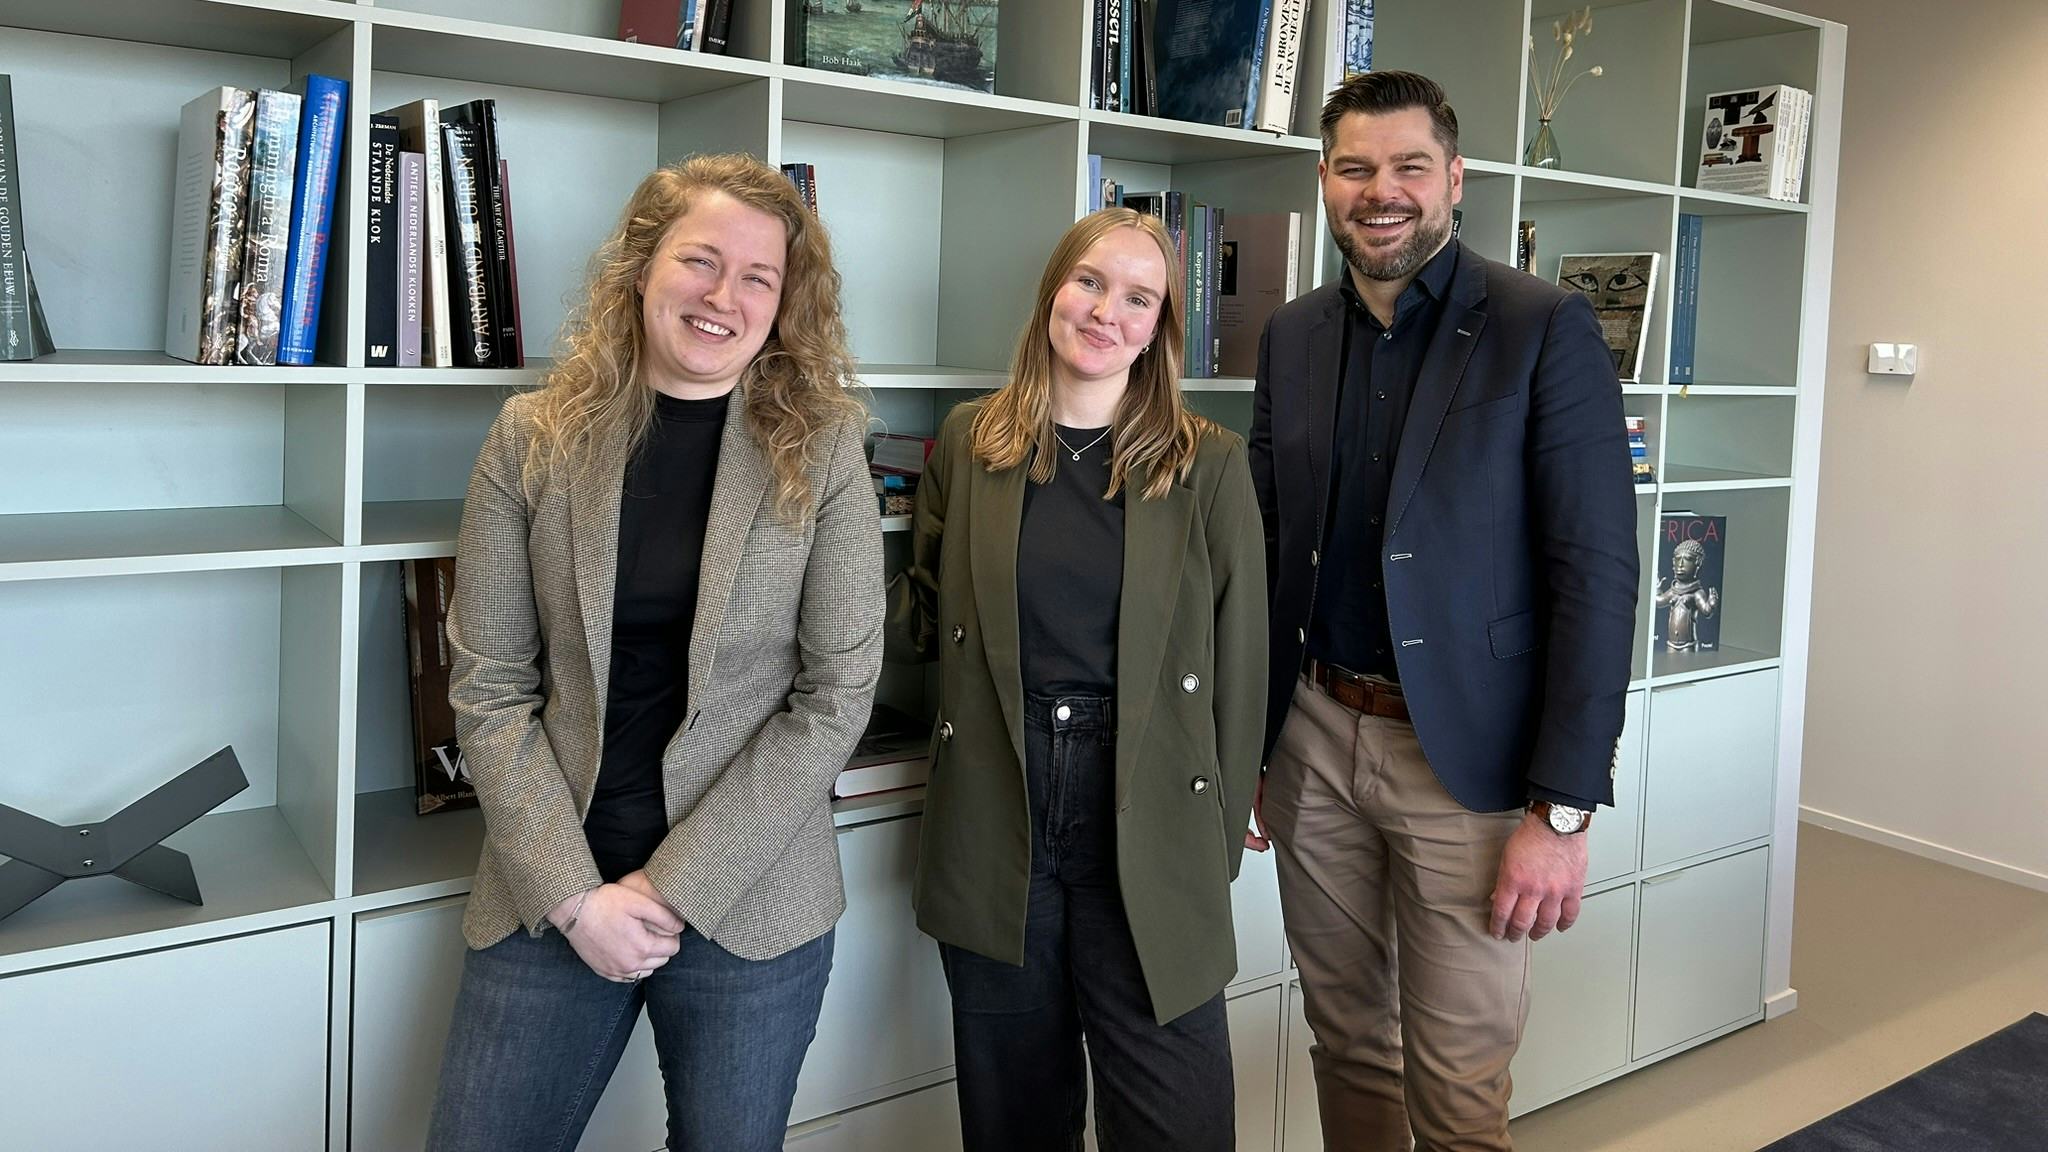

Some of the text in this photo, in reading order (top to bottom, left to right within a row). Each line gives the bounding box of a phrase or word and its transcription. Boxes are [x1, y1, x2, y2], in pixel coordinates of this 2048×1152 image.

[822, 54, 862, 67] Bob Haak
[1274, 62, 1284, 87] LES
[1282, 75, 1291, 95] DU
[427, 121, 441, 181] CLOCKS
[0, 187, 9, 203] DE
[370, 142, 382, 243] STAANDE KLOK
[384, 144, 394, 204] De Nederlandse
[456, 157, 479, 216] UHREN
[0, 207, 13, 258] GOUDEN
[261, 216, 272, 226] a
[407, 161, 419, 322] ANTIEKE NEDERLANDSE KLOKKEN
[492, 185, 506, 261] THE ART OF CARTIER
[1518, 228, 1526, 255] Dutch
[256, 232, 279, 283] Roma
[1195, 251, 1204, 279] Koper
[3, 262, 16, 296] EEUW
[465, 246, 490, 336] ARMBAND
[1194, 278, 1203, 289] &
